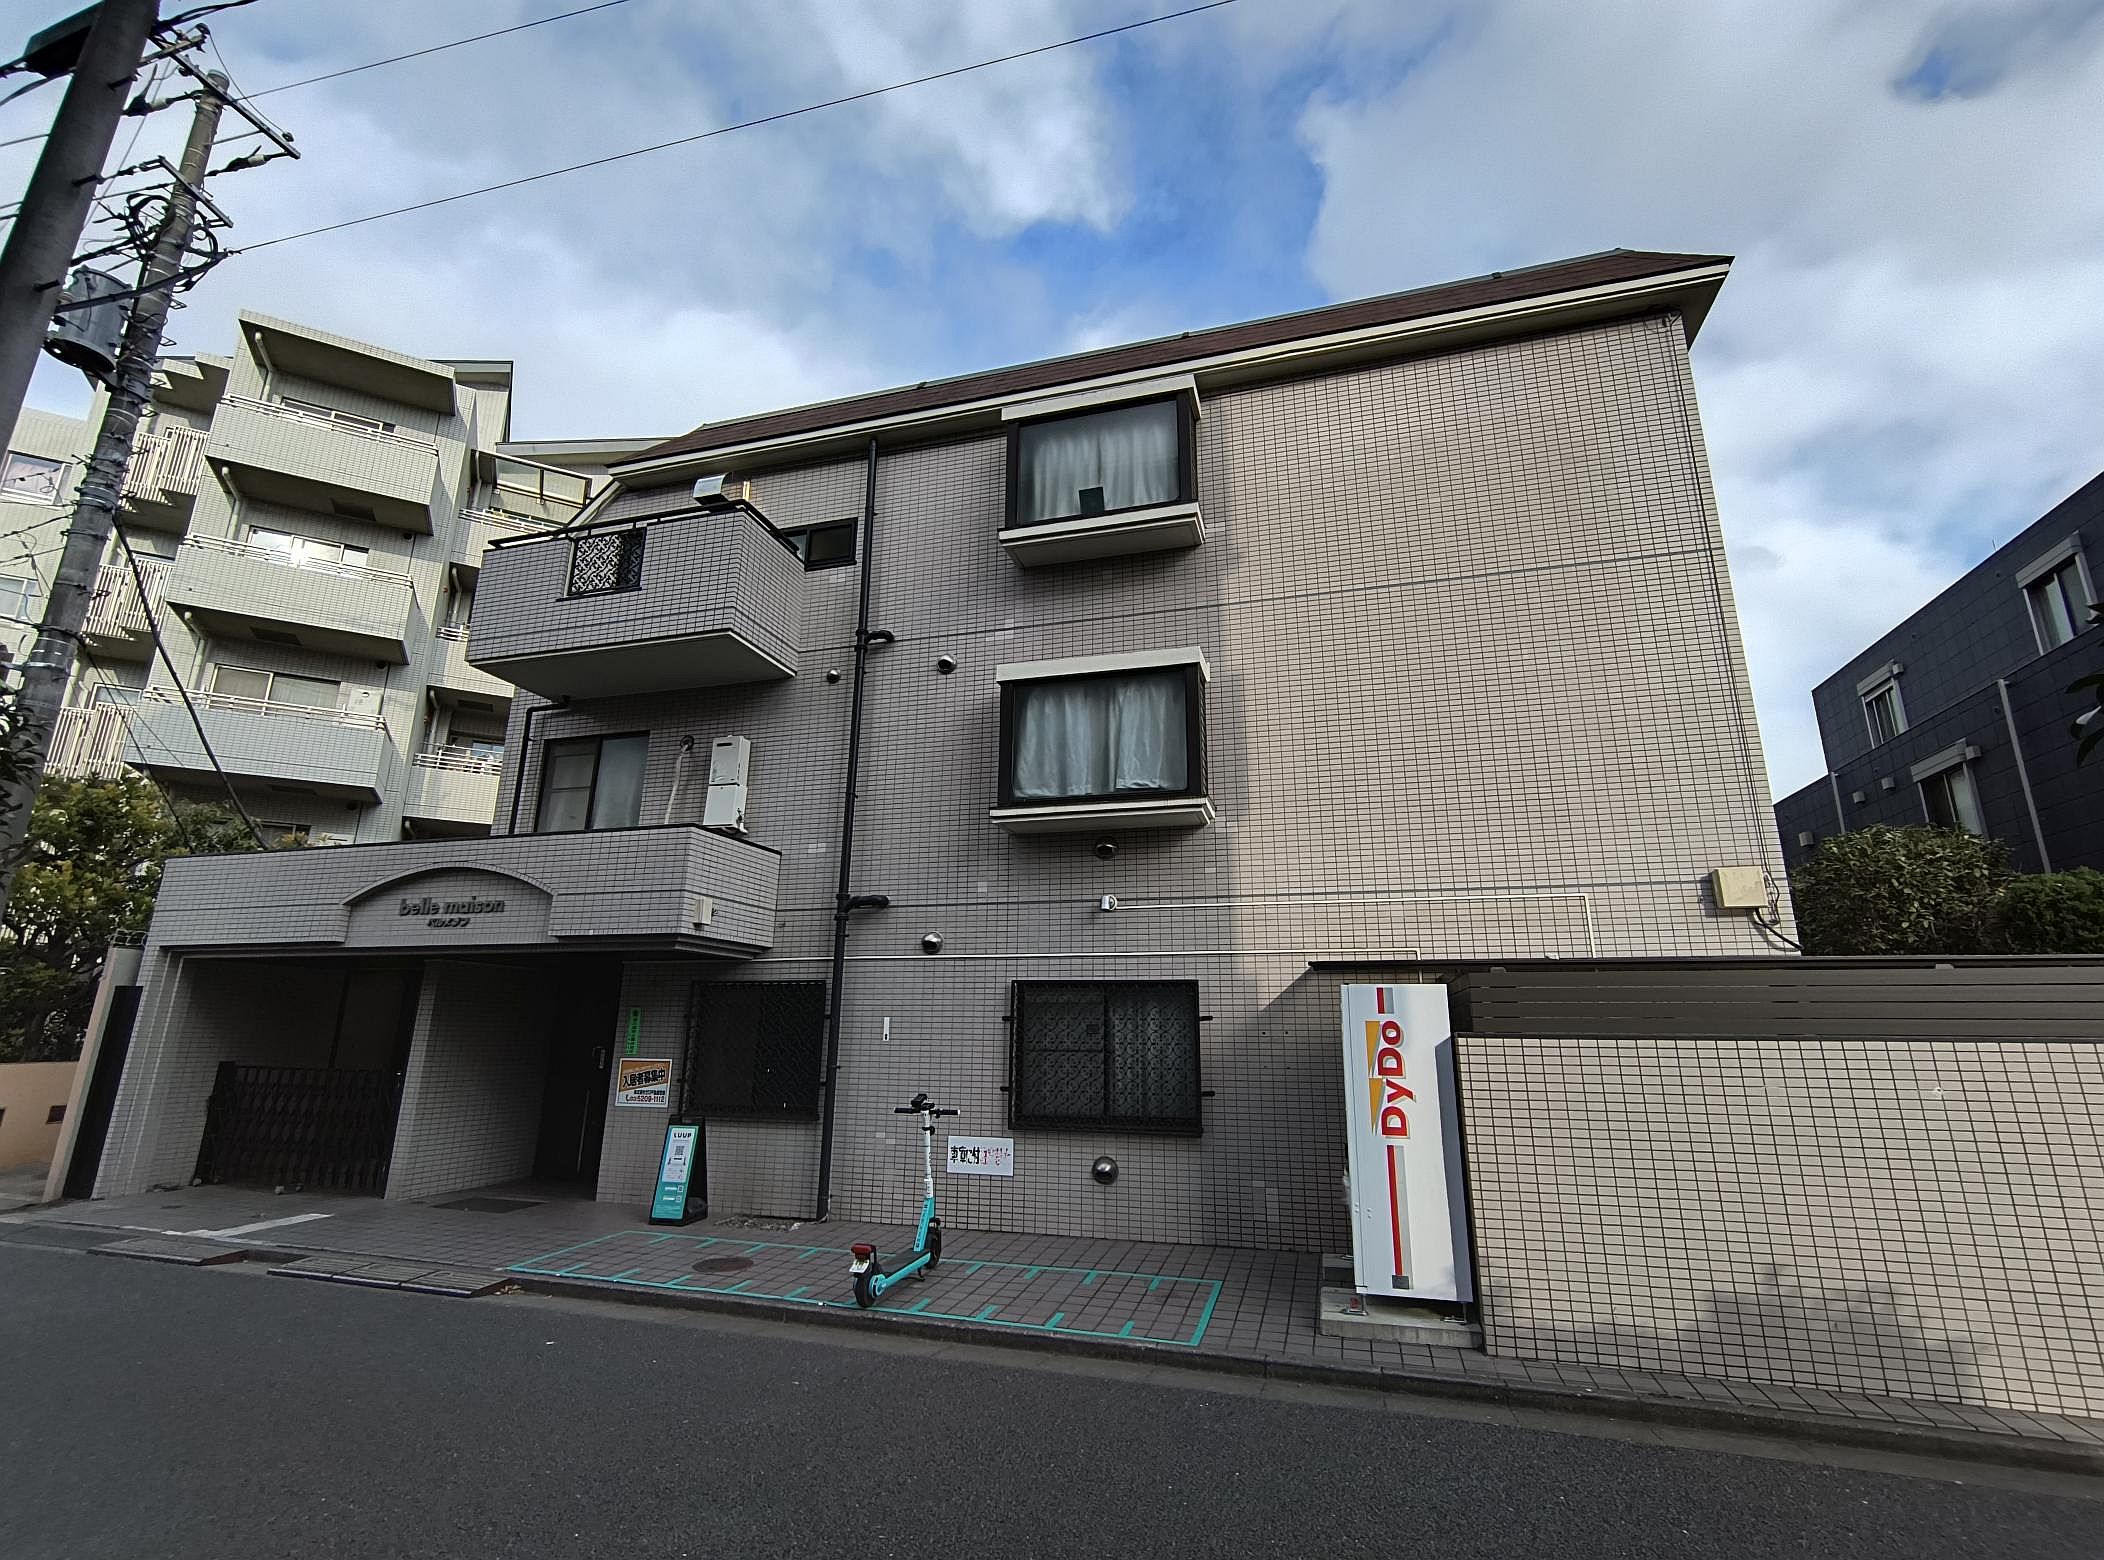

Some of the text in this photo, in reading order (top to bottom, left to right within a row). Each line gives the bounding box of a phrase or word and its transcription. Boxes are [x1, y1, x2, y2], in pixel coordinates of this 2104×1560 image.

[400, 896, 504, 916] belle maison
[622, 1068, 665, 1087] 入居者募集中
[1377, 1020, 1415, 1138] DyDo
